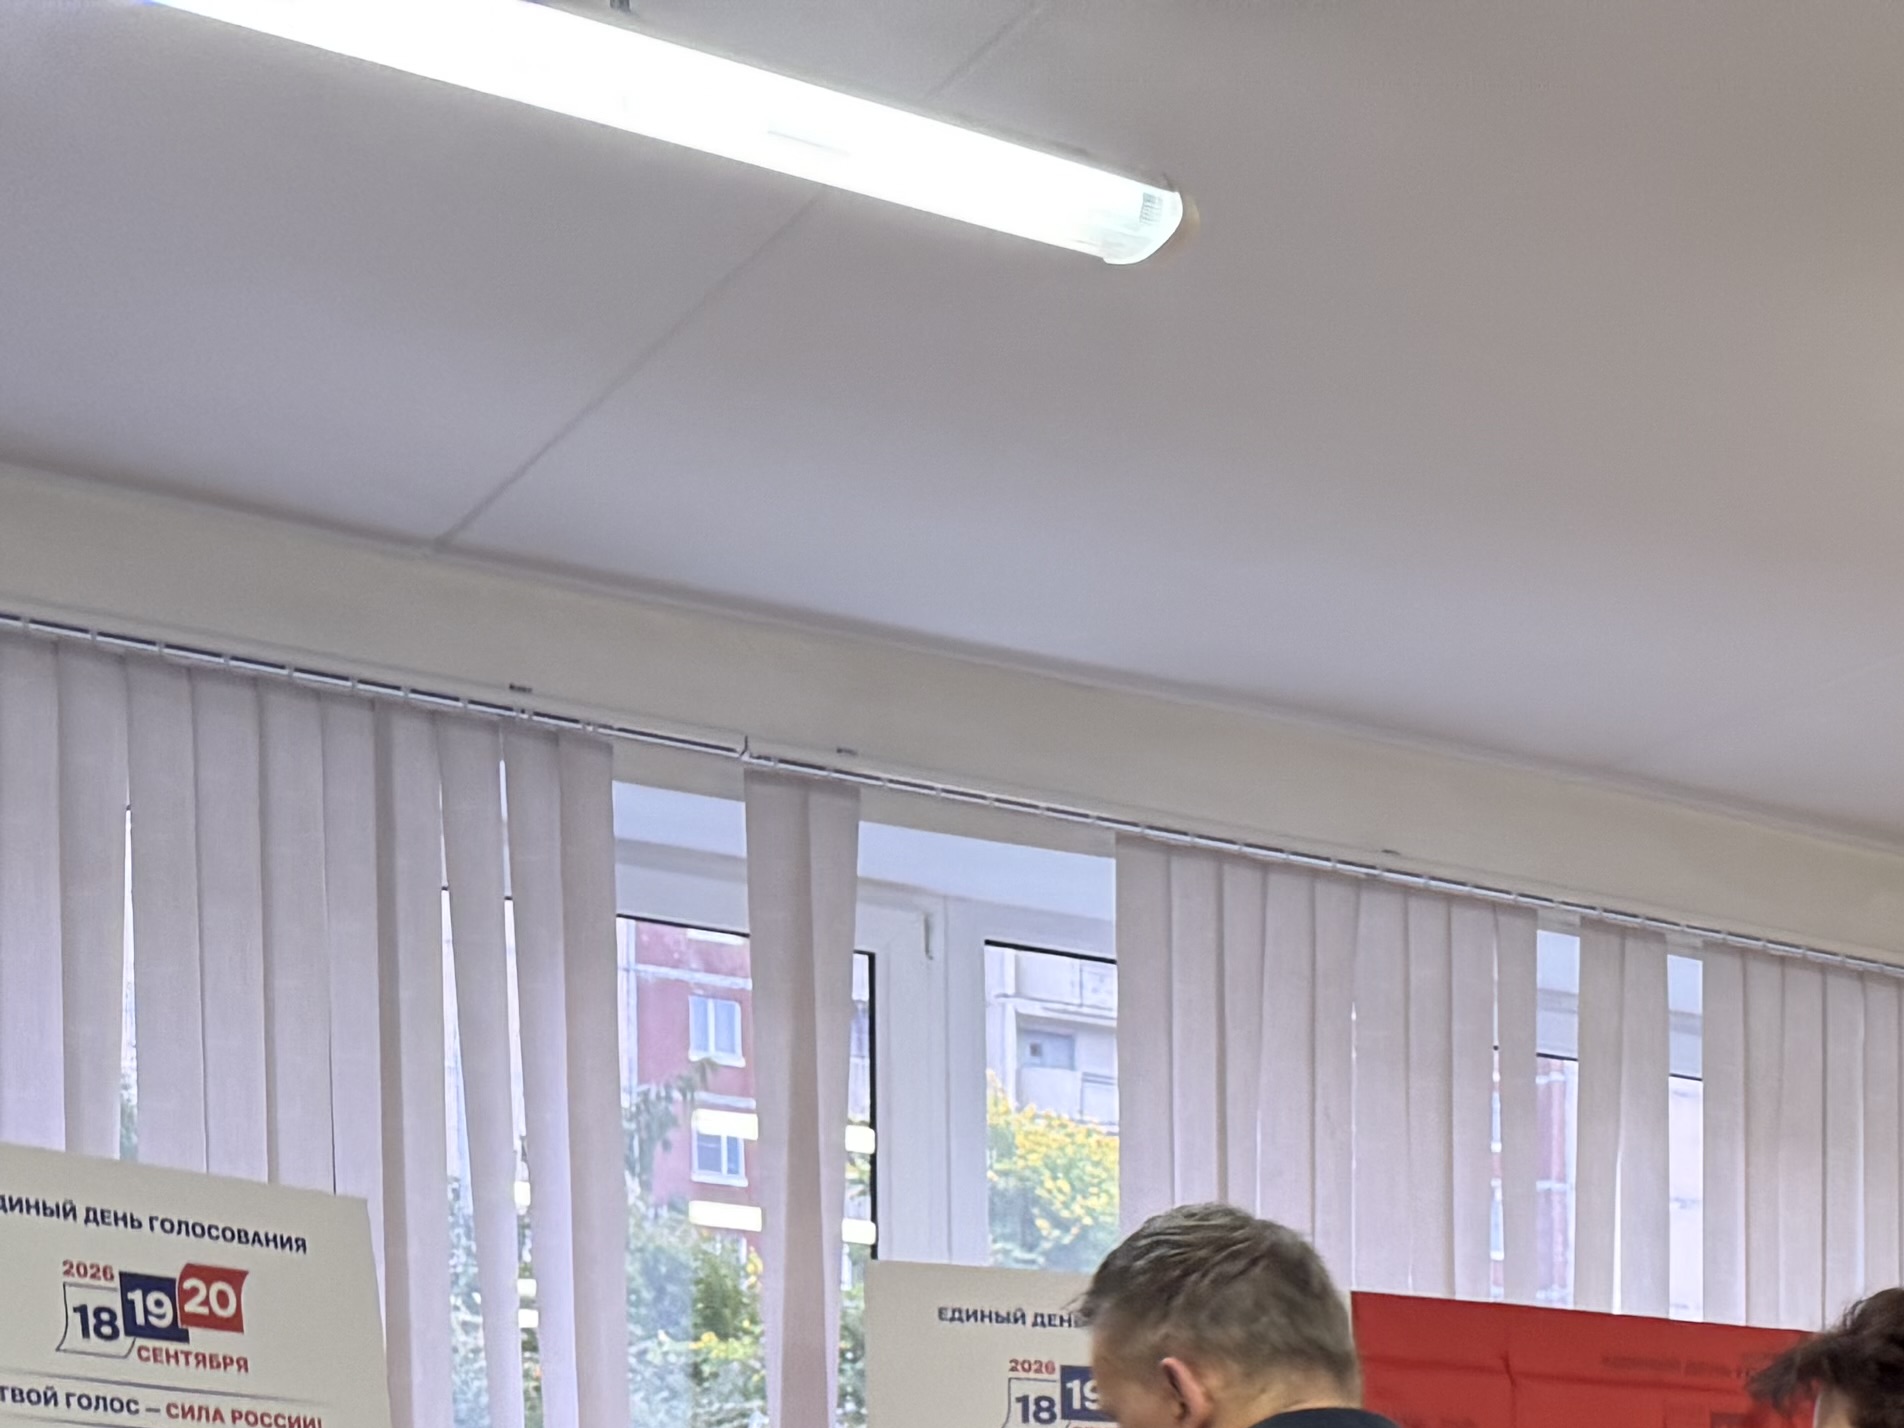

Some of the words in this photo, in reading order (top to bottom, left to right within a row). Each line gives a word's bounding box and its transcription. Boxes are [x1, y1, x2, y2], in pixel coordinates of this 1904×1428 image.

[84, 1205, 143, 1230] ДЕНЬ
[149, 1215, 308, 1254] ГОЛОСОВАНИЯ
[62, 1259, 115, 1282] 2026
[72, 1303, 120, 1342] 18
[127, 1288, 174, 1329] 19
[182, 1277, 238, 1318] 20
[938, 1307, 1026, 1326] ЕДИНЫЙ
[136, 1344, 249, 1373] СЕНТЯБРЯ
[1009, 1359, 1056, 1375] 2026
[0, 1385, 58, 1407] ТВОЙ
[65, 1391, 140, 1415] ГОЛОС
[165, 1402, 225, 1425] СИЛА
[1014, 1395, 1058, 1425] 18
